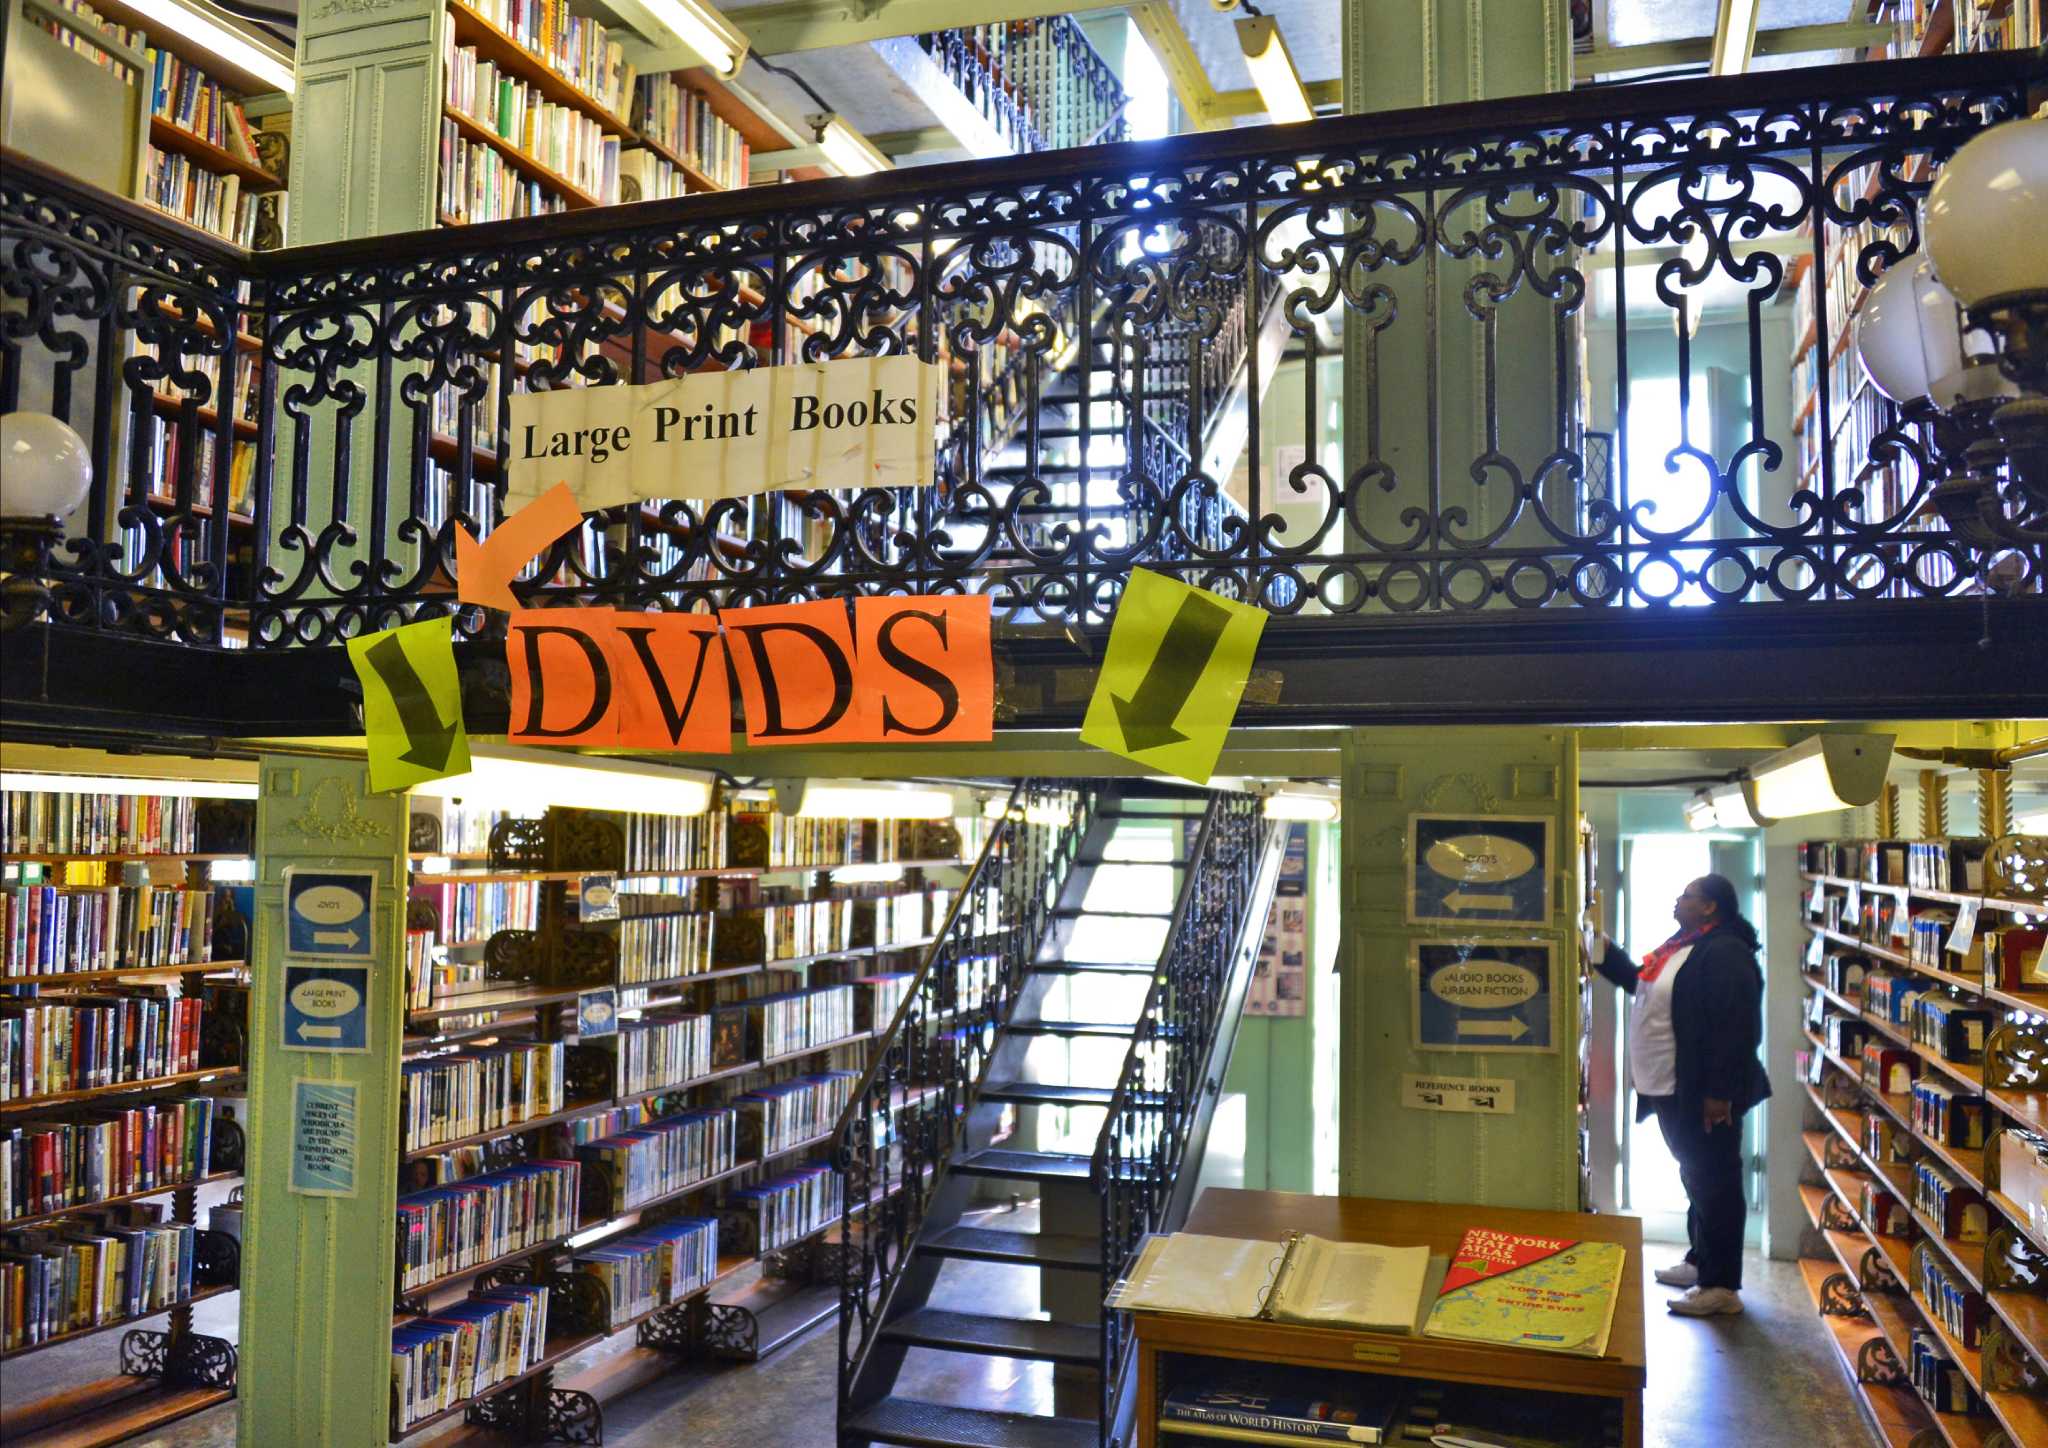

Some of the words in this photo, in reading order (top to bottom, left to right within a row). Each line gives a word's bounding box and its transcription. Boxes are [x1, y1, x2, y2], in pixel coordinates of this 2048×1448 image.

[521, 423, 631, 464] Large
[653, 403, 758, 444] Print
[789, 390, 918, 432] Books
[1446, 973, 1484, 983] AUDIO
[1487, 974, 1525, 983] BOOKS
[1443, 986, 1481, 995] URBAN
[1484, 986, 1529, 996] FICTION
[1415, 1080, 1466, 1092] REFERENCE
[1468, 1084, 1501, 1094] BOOKS
[1463, 1237, 1516, 1253] STATE
[1467, 1229, 1509, 1242] NEW
[1513, 1236, 1561, 1250] YORK
[1461, 1244, 1514, 1259] ATLAS
[1511, 1285, 1543, 1295] TOPO
[1547, 1288, 1582, 1299] MAPS
[1497, 1297, 1544, 1309] ENTIRE
[1547, 1302, 1585, 1312] STATE
[1176, 1408, 1191, 1417] THE
[1192, 1410, 1215, 1421] ATLAS
[1215, 1414, 1227, 1422] OF
[1227, 1413, 1270, 1429] WORLD
[1272, 1418, 1321, 1435] HISTORY
